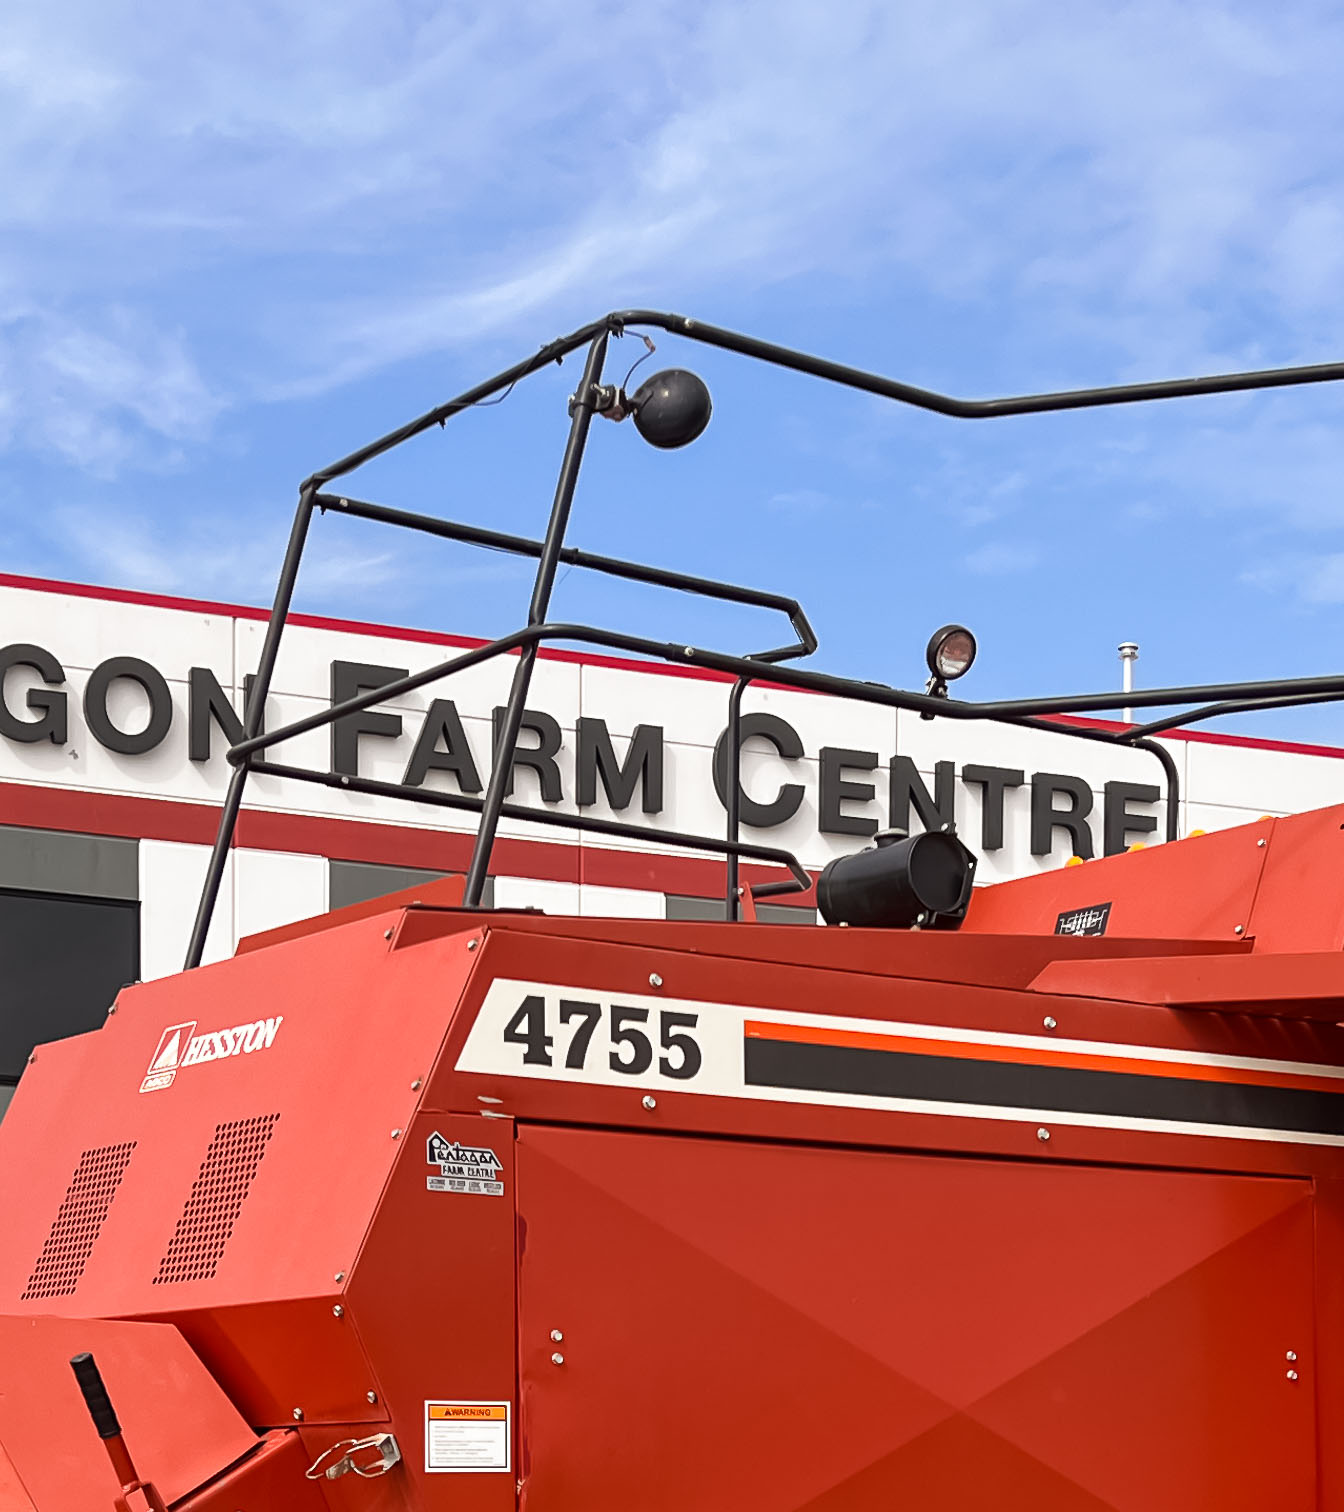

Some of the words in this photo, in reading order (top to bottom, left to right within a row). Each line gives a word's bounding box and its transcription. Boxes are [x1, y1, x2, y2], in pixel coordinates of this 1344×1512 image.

[329, 659, 664, 814] FARM
[711, 712, 1162, 858] CENTRE
[181, 1015, 284, 1067] HESSTON
[503, 995, 702, 1080] 4755
[452, 1408, 491, 1417] WARNING
